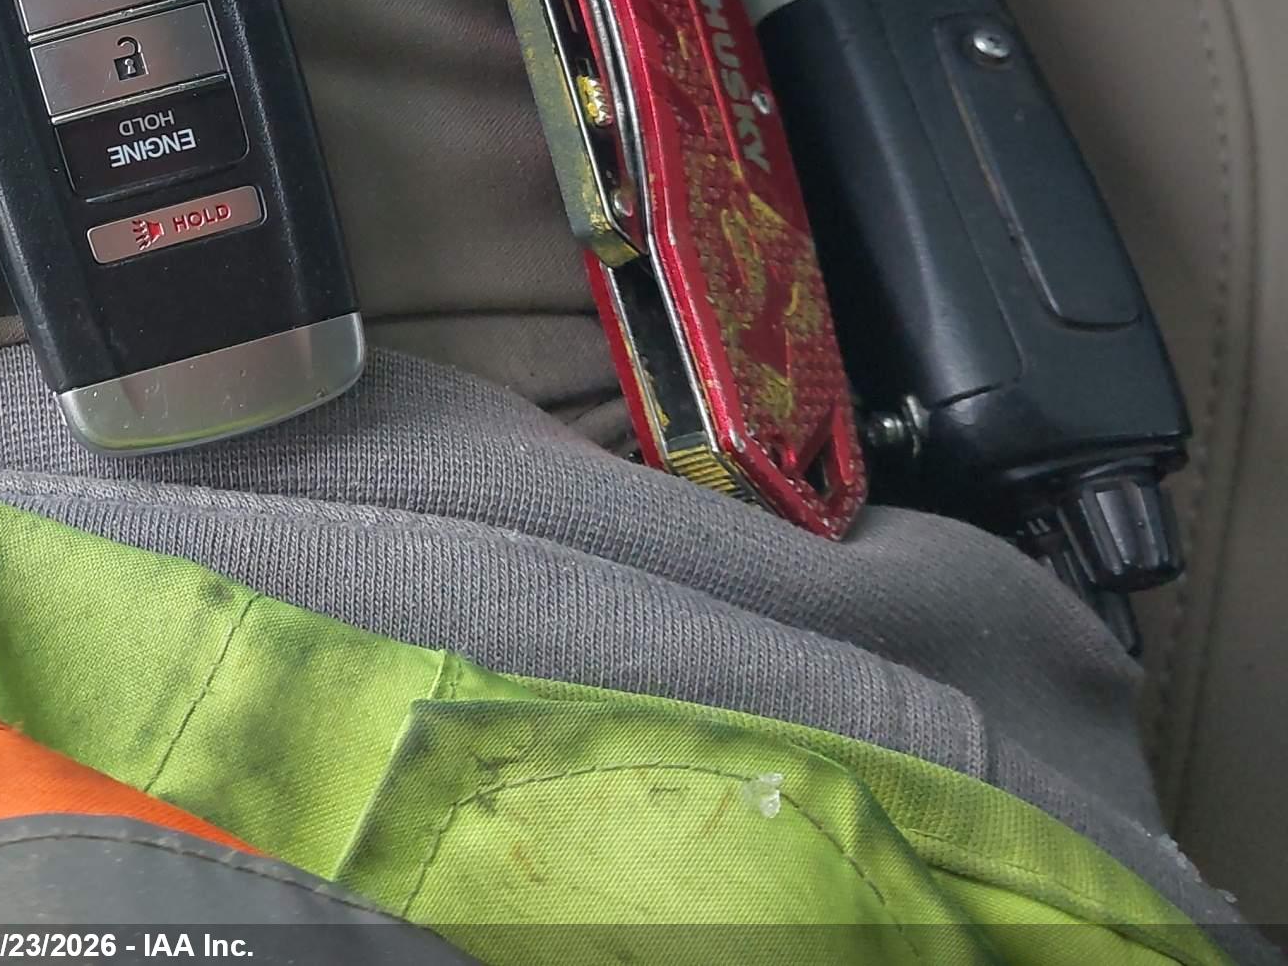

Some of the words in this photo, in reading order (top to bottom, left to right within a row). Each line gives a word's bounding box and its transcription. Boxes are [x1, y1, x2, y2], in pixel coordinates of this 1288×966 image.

[118, 109, 176, 136] HOLD
[107, 128, 197, 168] ENGINE
[172, 204, 232, 233] HOLD
